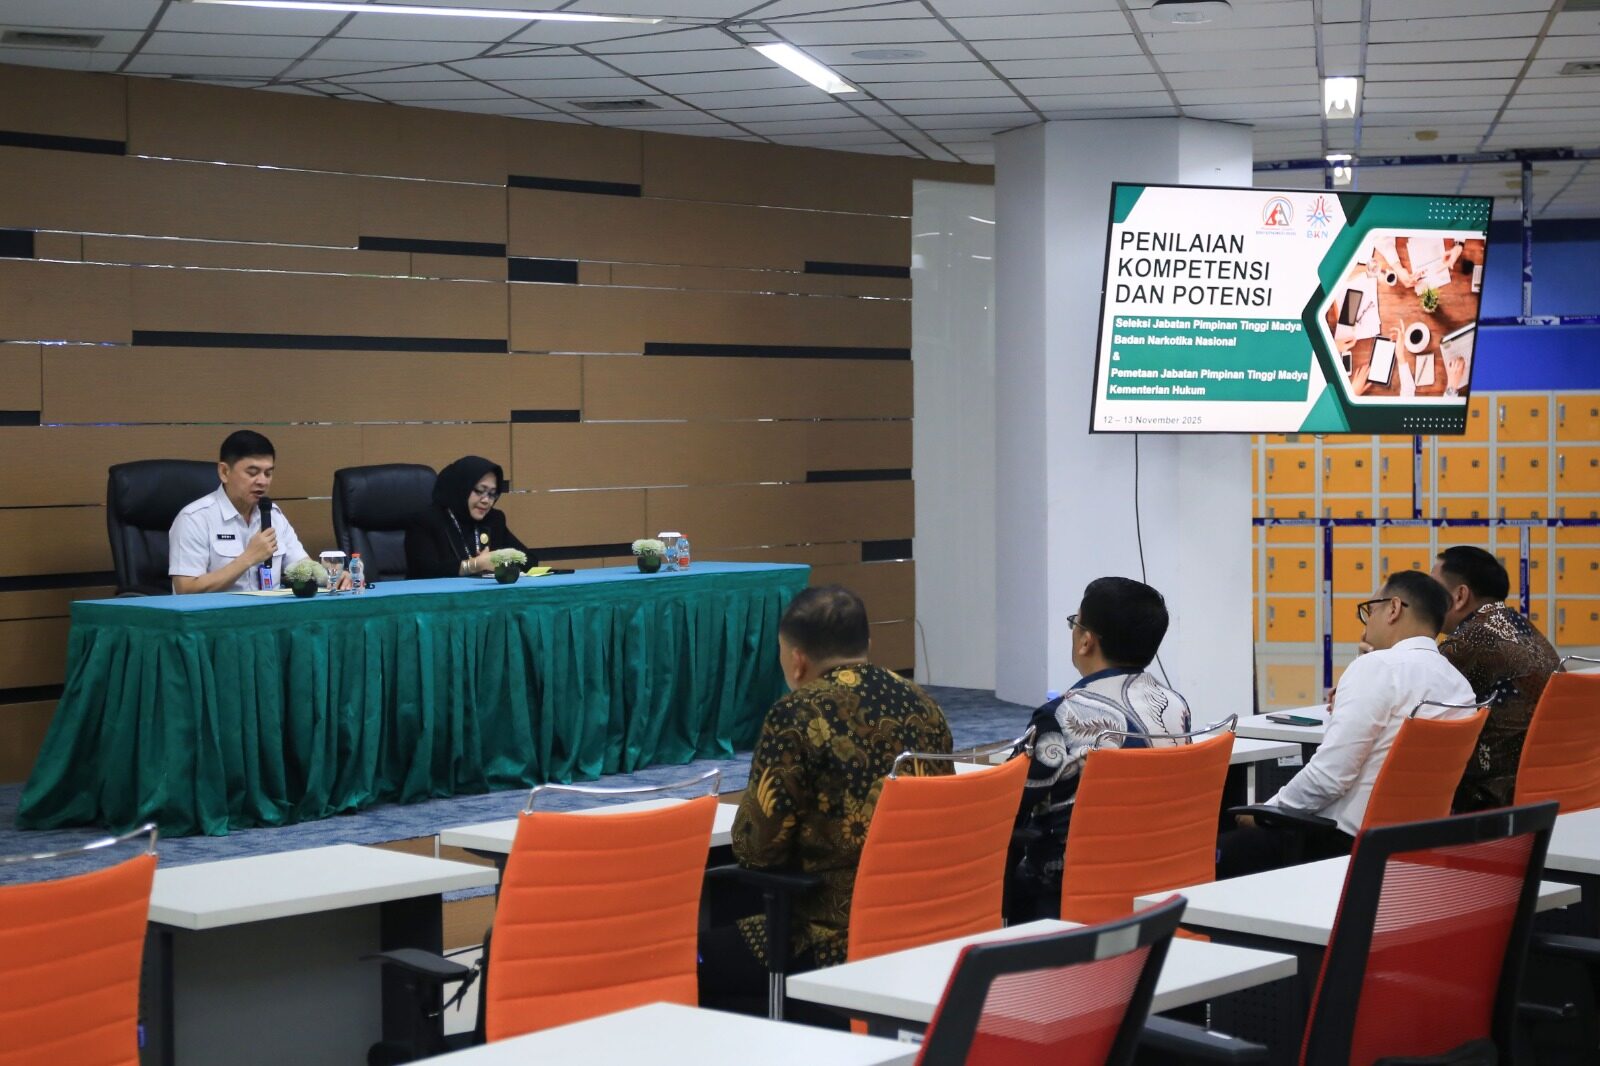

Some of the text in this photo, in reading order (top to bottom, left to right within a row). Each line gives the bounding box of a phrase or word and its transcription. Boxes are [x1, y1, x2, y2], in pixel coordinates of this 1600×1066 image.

[1307, 230, 1328, 239] BKN
[1120, 231, 1244, 253] PENILAIAN
[1118, 258, 1270, 281] KOMPETENSI
[1115, 284, 1272, 306] DAN POTENSI
[1115, 318, 1302, 333] Seleksi Jabatan Pimpinan Tinggi Madya
[1114, 335, 1237, 347] Badan Narkotika Nasional
[1112, 352, 1120, 361] &
[1111, 368, 1308, 382] Pemetaan Jabatan Pimpinan Tinggi Madya
[1109, 385, 1206, 395] Kementerian Hukum
[1103, 416, 1113, 424] 12
[1124, 416, 1133, 424] 13
[1135, 416, 1179, 425] November
[1182, 416, 1202, 425] 2025
